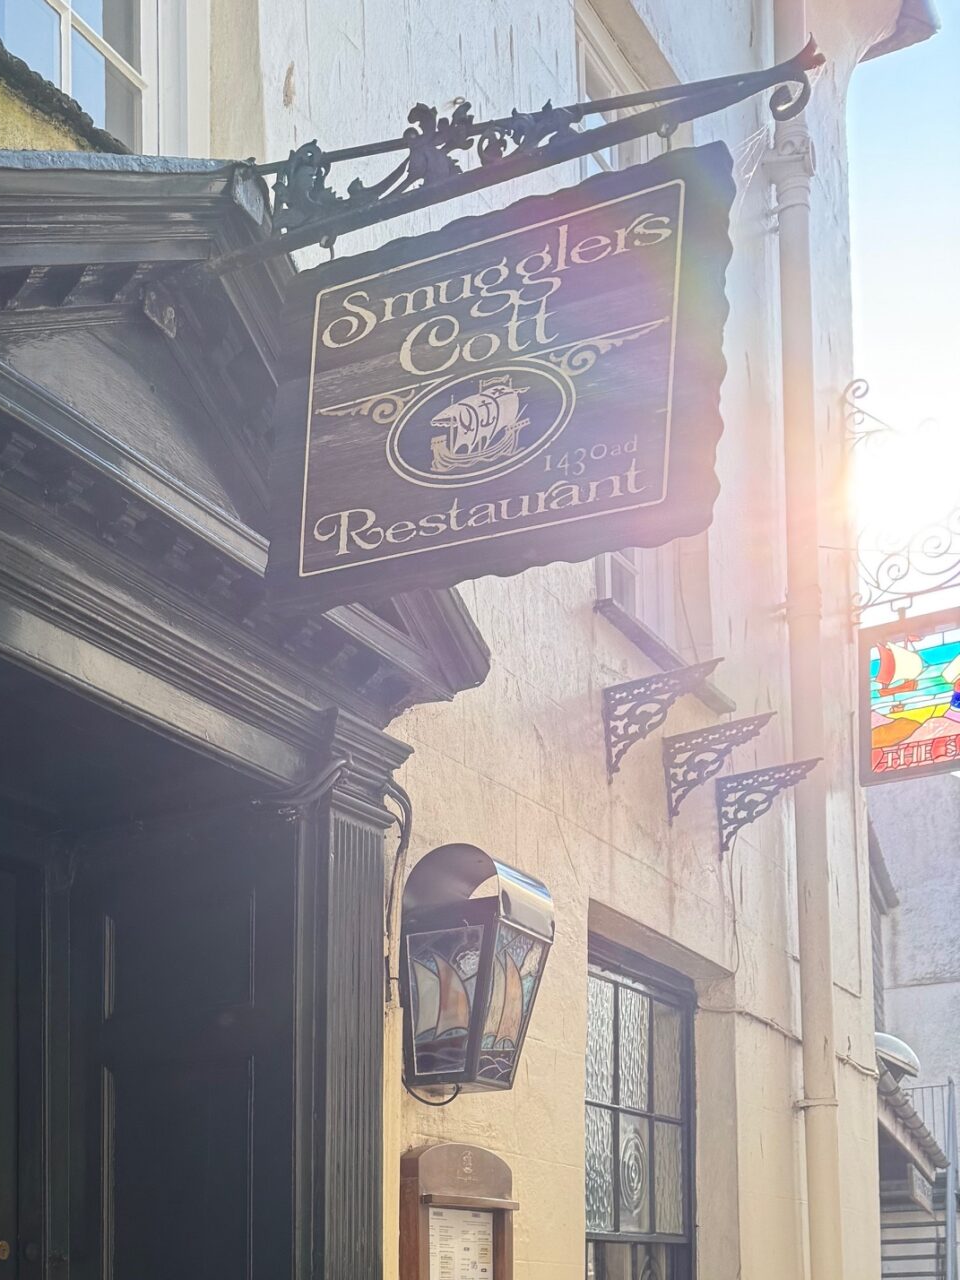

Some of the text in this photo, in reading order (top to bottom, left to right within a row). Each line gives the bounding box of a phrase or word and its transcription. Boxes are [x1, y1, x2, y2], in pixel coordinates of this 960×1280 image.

[322, 213, 672, 348] Smugglers
[399, 296, 559, 375] Cott
[314, 458, 647, 555] Restaurant
[884, 743, 932, 768] THE
